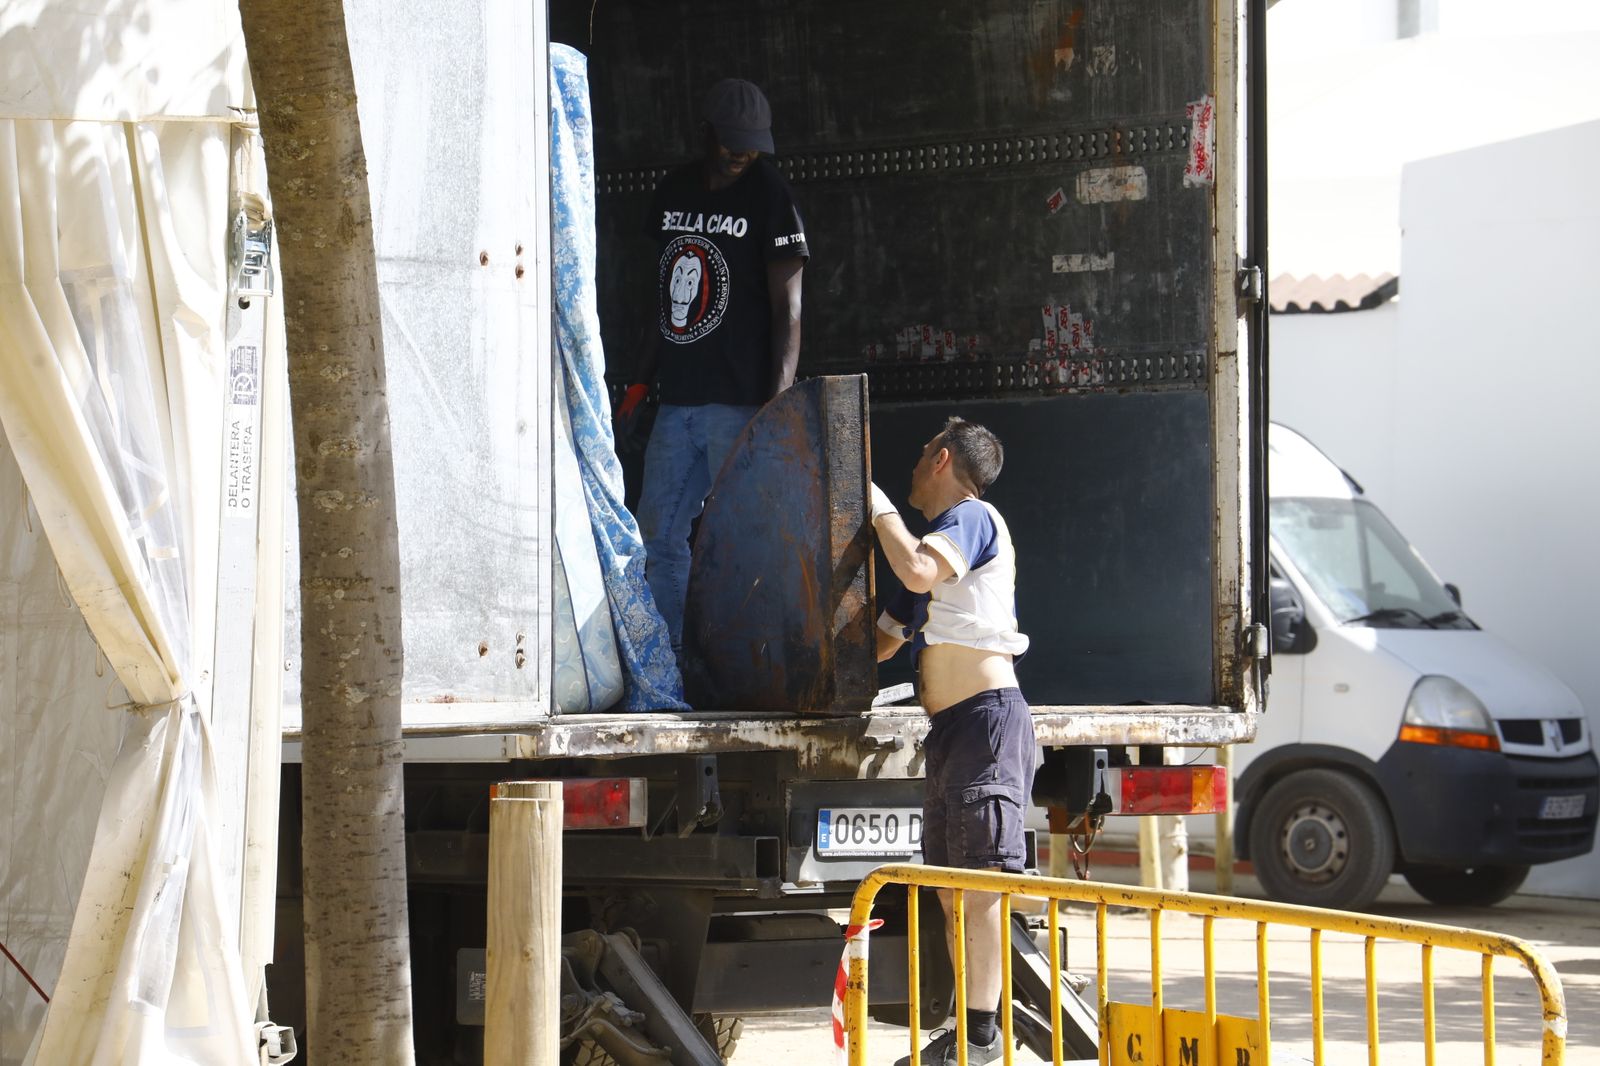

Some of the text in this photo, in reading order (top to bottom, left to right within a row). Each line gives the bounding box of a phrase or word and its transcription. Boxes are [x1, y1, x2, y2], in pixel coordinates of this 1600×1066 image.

[662, 211, 748, 238] BELLA CIAO
[716, 283, 728, 311] DENVER
[228, 420, 240, 508] DELANTERA
[241, 425, 253, 508] O TRASERA
[821, 834, 827, 842] E
[835, 814, 899, 844] 0650
